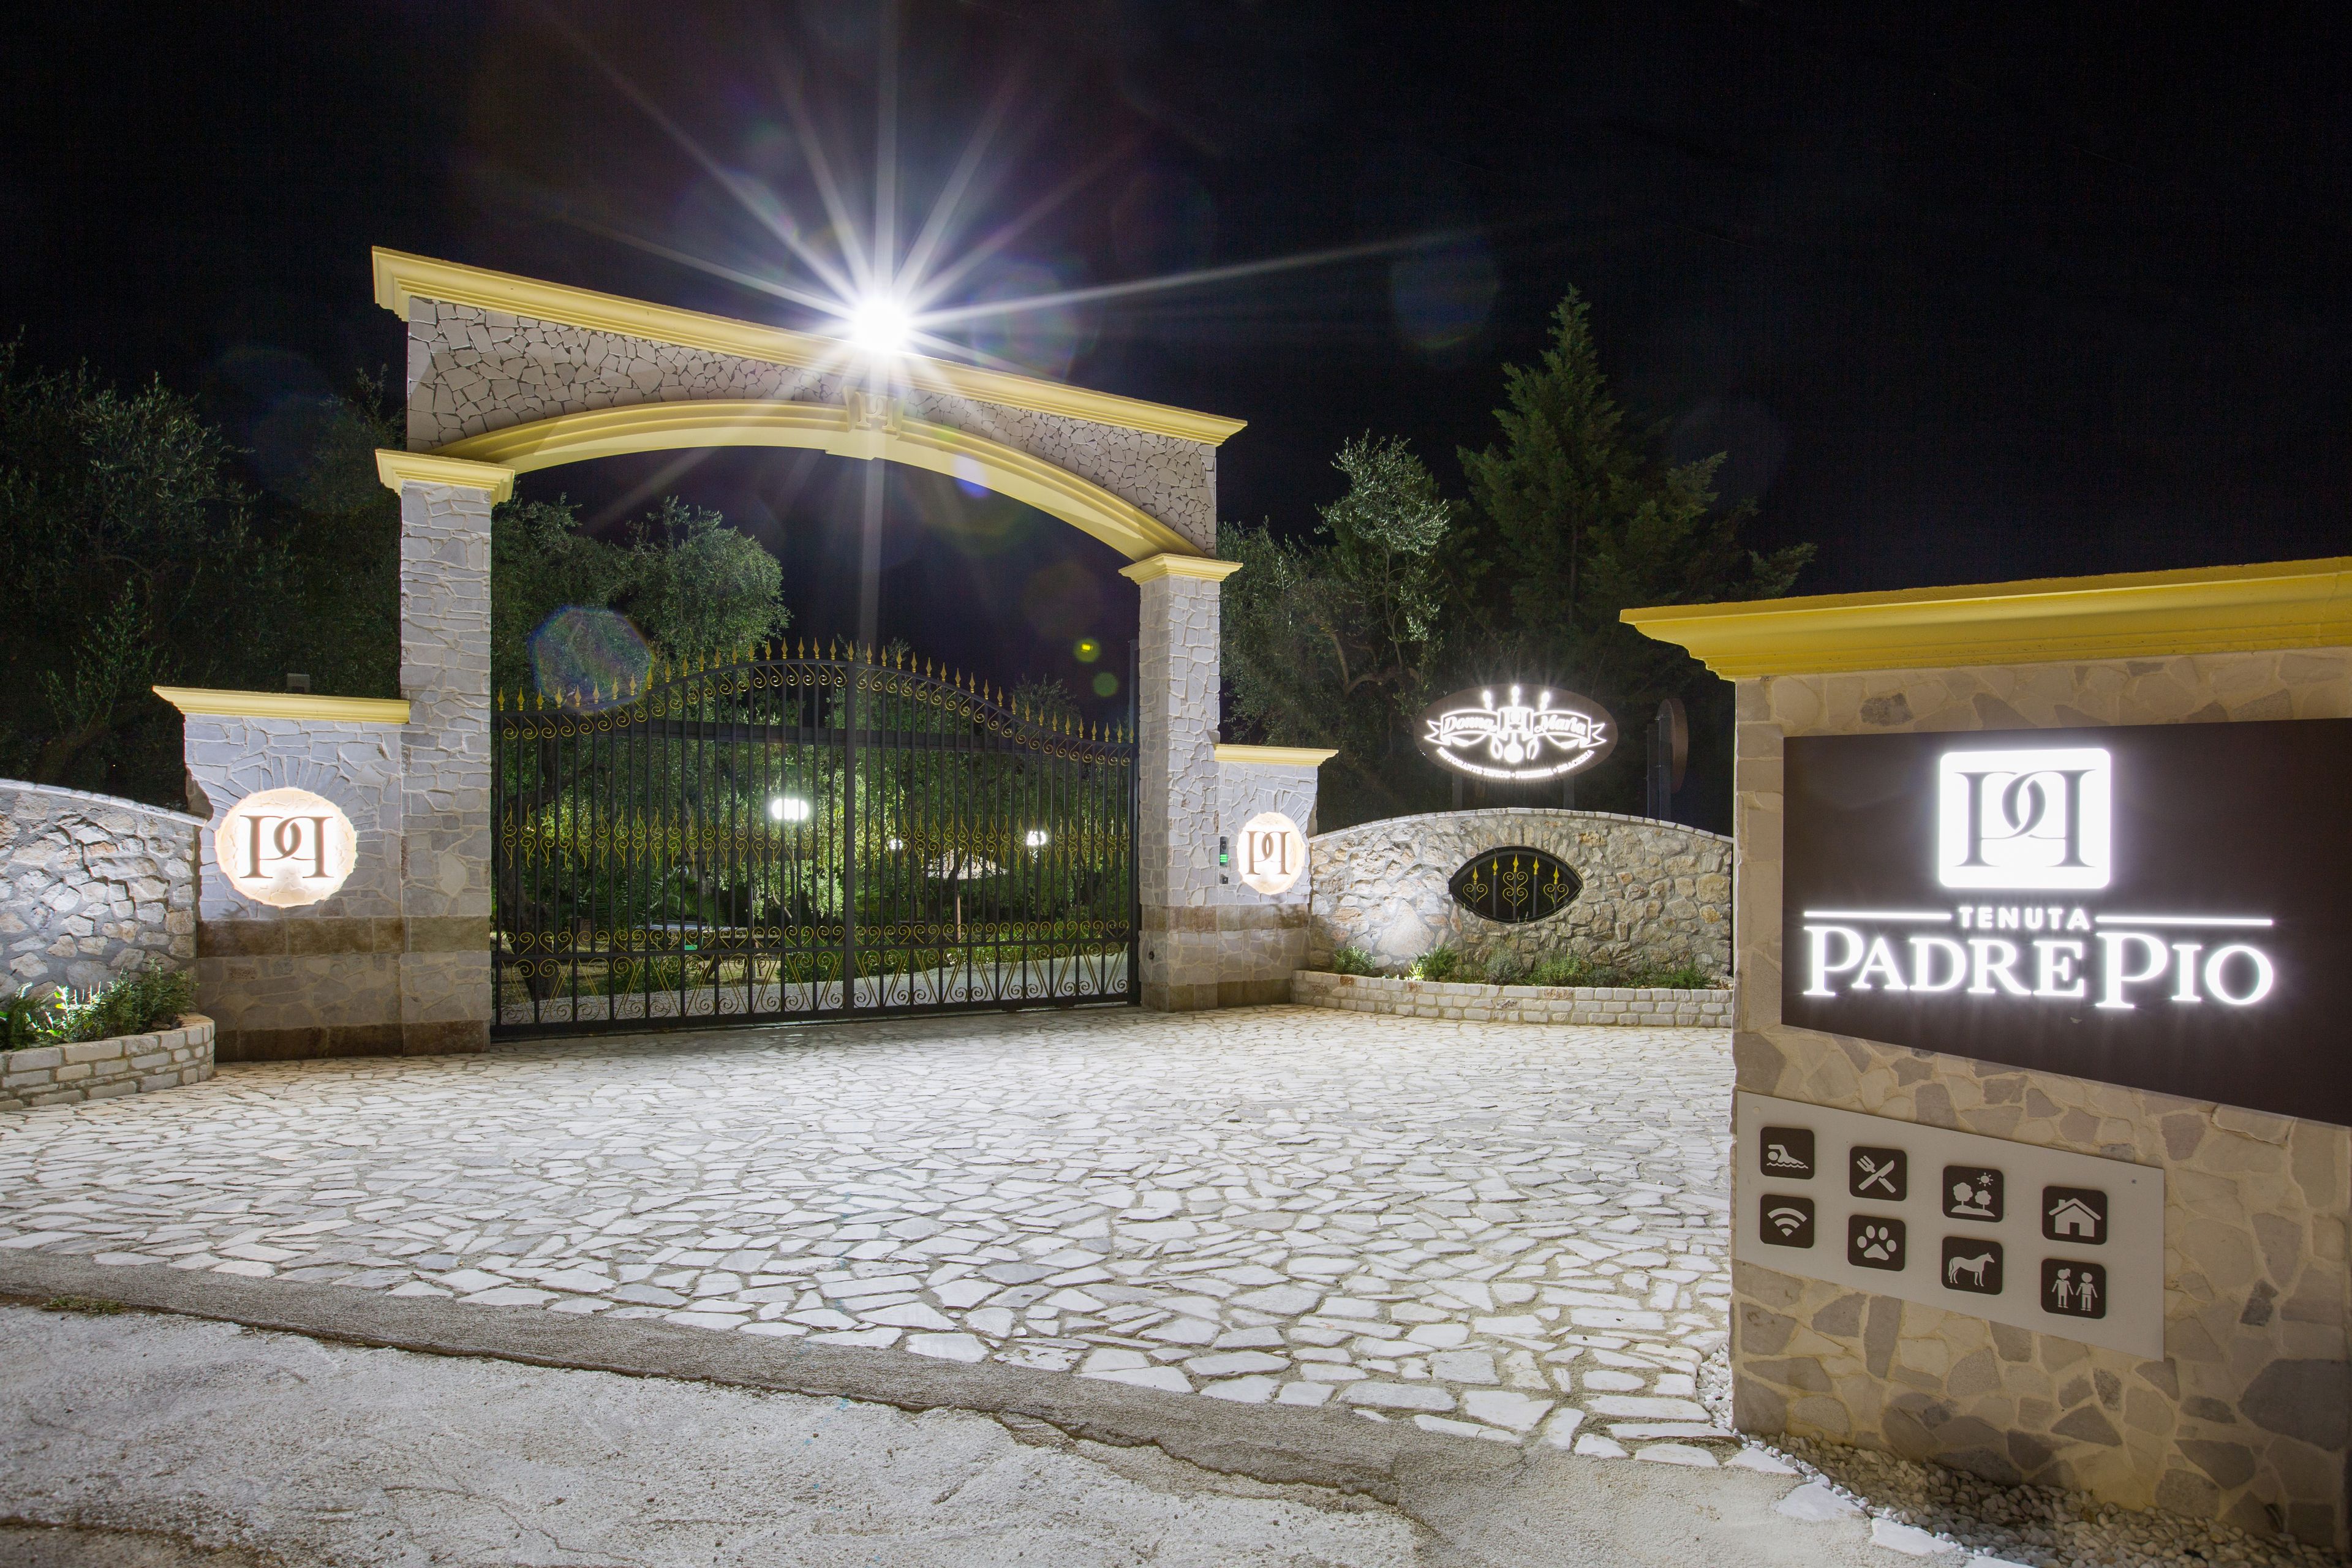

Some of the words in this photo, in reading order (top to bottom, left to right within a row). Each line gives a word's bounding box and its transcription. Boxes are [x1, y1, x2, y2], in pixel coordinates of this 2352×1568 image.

[1444, 716, 1496, 734] Donna
[1538, 715, 1586, 734] Maria
[1958, 907, 2090, 930] TENUTA
[1803, 925, 2086, 997] PADRE
[2095, 932, 2274, 1009] PIO
